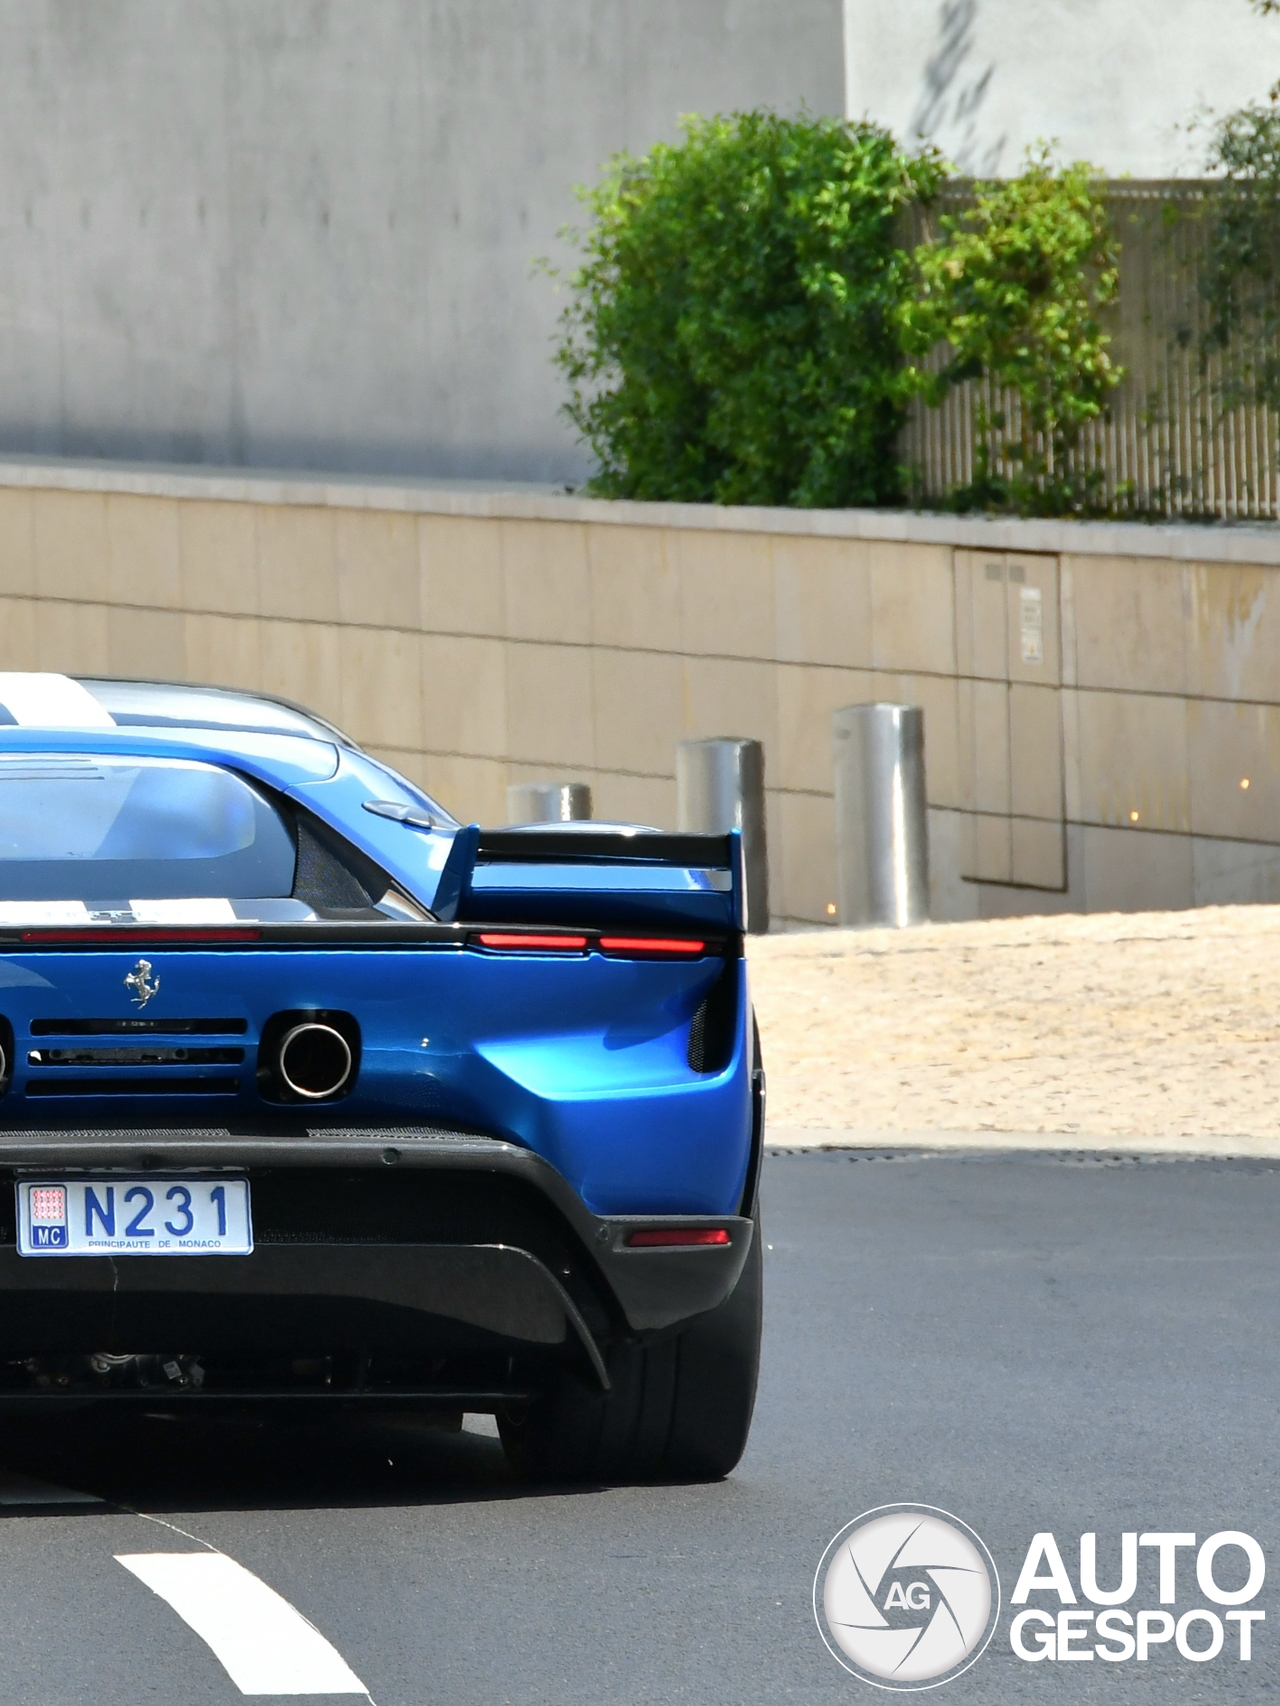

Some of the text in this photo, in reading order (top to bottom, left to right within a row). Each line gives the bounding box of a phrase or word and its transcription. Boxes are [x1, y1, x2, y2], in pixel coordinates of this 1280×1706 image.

[85, 1186, 227, 1237] N231
[37, 1228, 61, 1246] MC
[88, 1240, 221, 1249] PRINCIPAUTE DE MONACO
